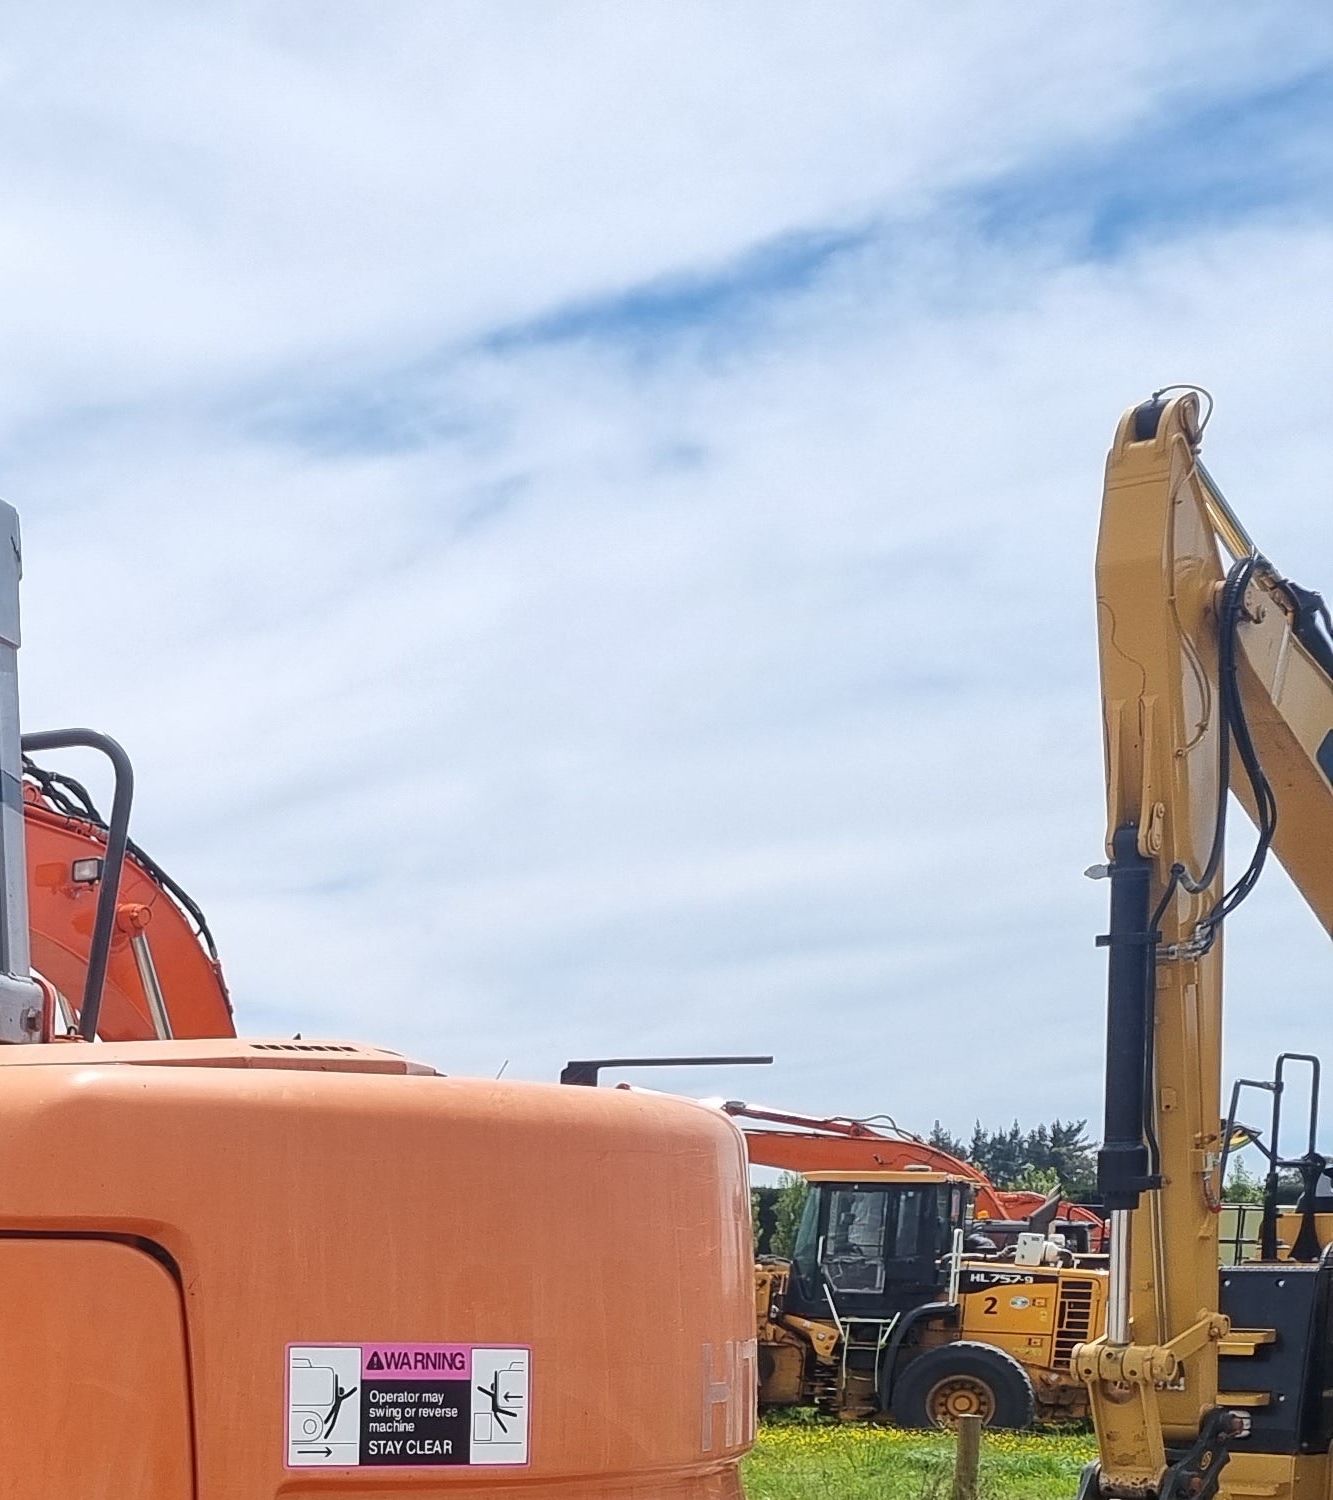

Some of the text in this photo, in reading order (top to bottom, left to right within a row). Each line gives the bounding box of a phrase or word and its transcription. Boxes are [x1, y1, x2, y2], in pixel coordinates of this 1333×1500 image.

[983, 1296, 998, 1315] 2
[384, 1352, 465, 1370] WARNING
[369, 1390, 444, 1405] Operator may
[369, 1405, 458, 1420] swing or reverse
[369, 1420, 415, 1432] machine
[368, 1440, 452, 1454] STAY CLEAR
